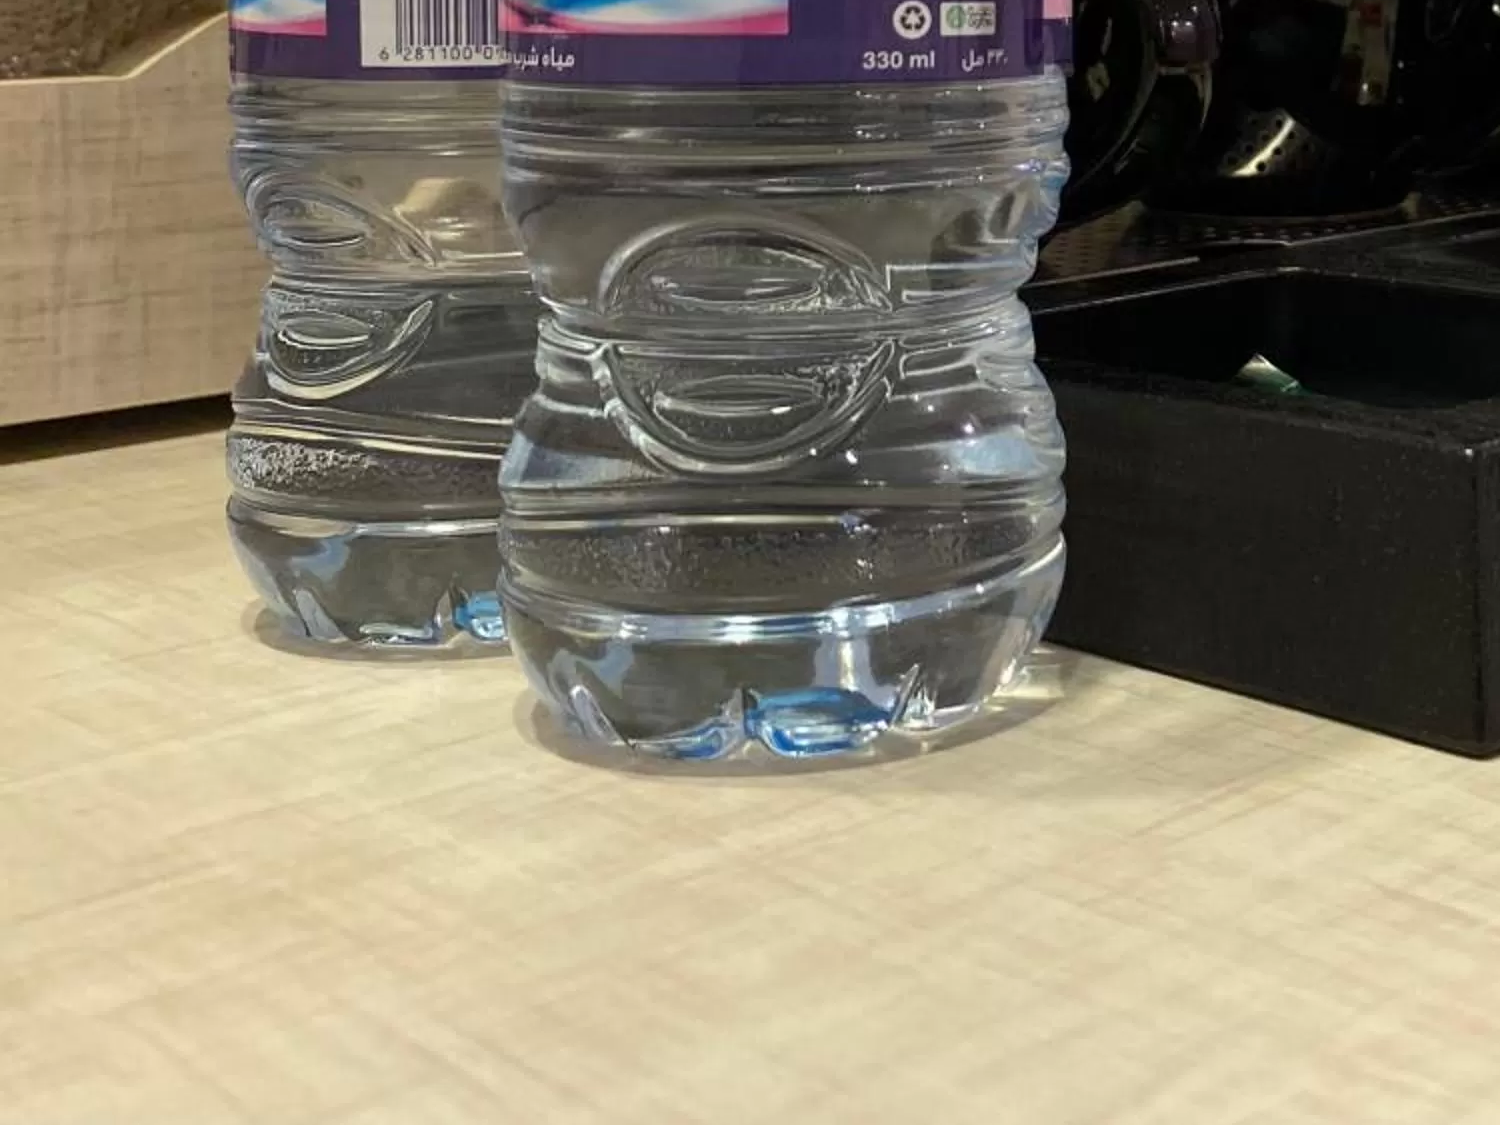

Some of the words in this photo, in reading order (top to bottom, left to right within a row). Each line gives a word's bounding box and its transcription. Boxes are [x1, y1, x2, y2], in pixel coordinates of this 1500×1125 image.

[863, 50, 903, 70] 330
[909, 50, 935, 69] ml
[961, 48, 985, 73] مل
